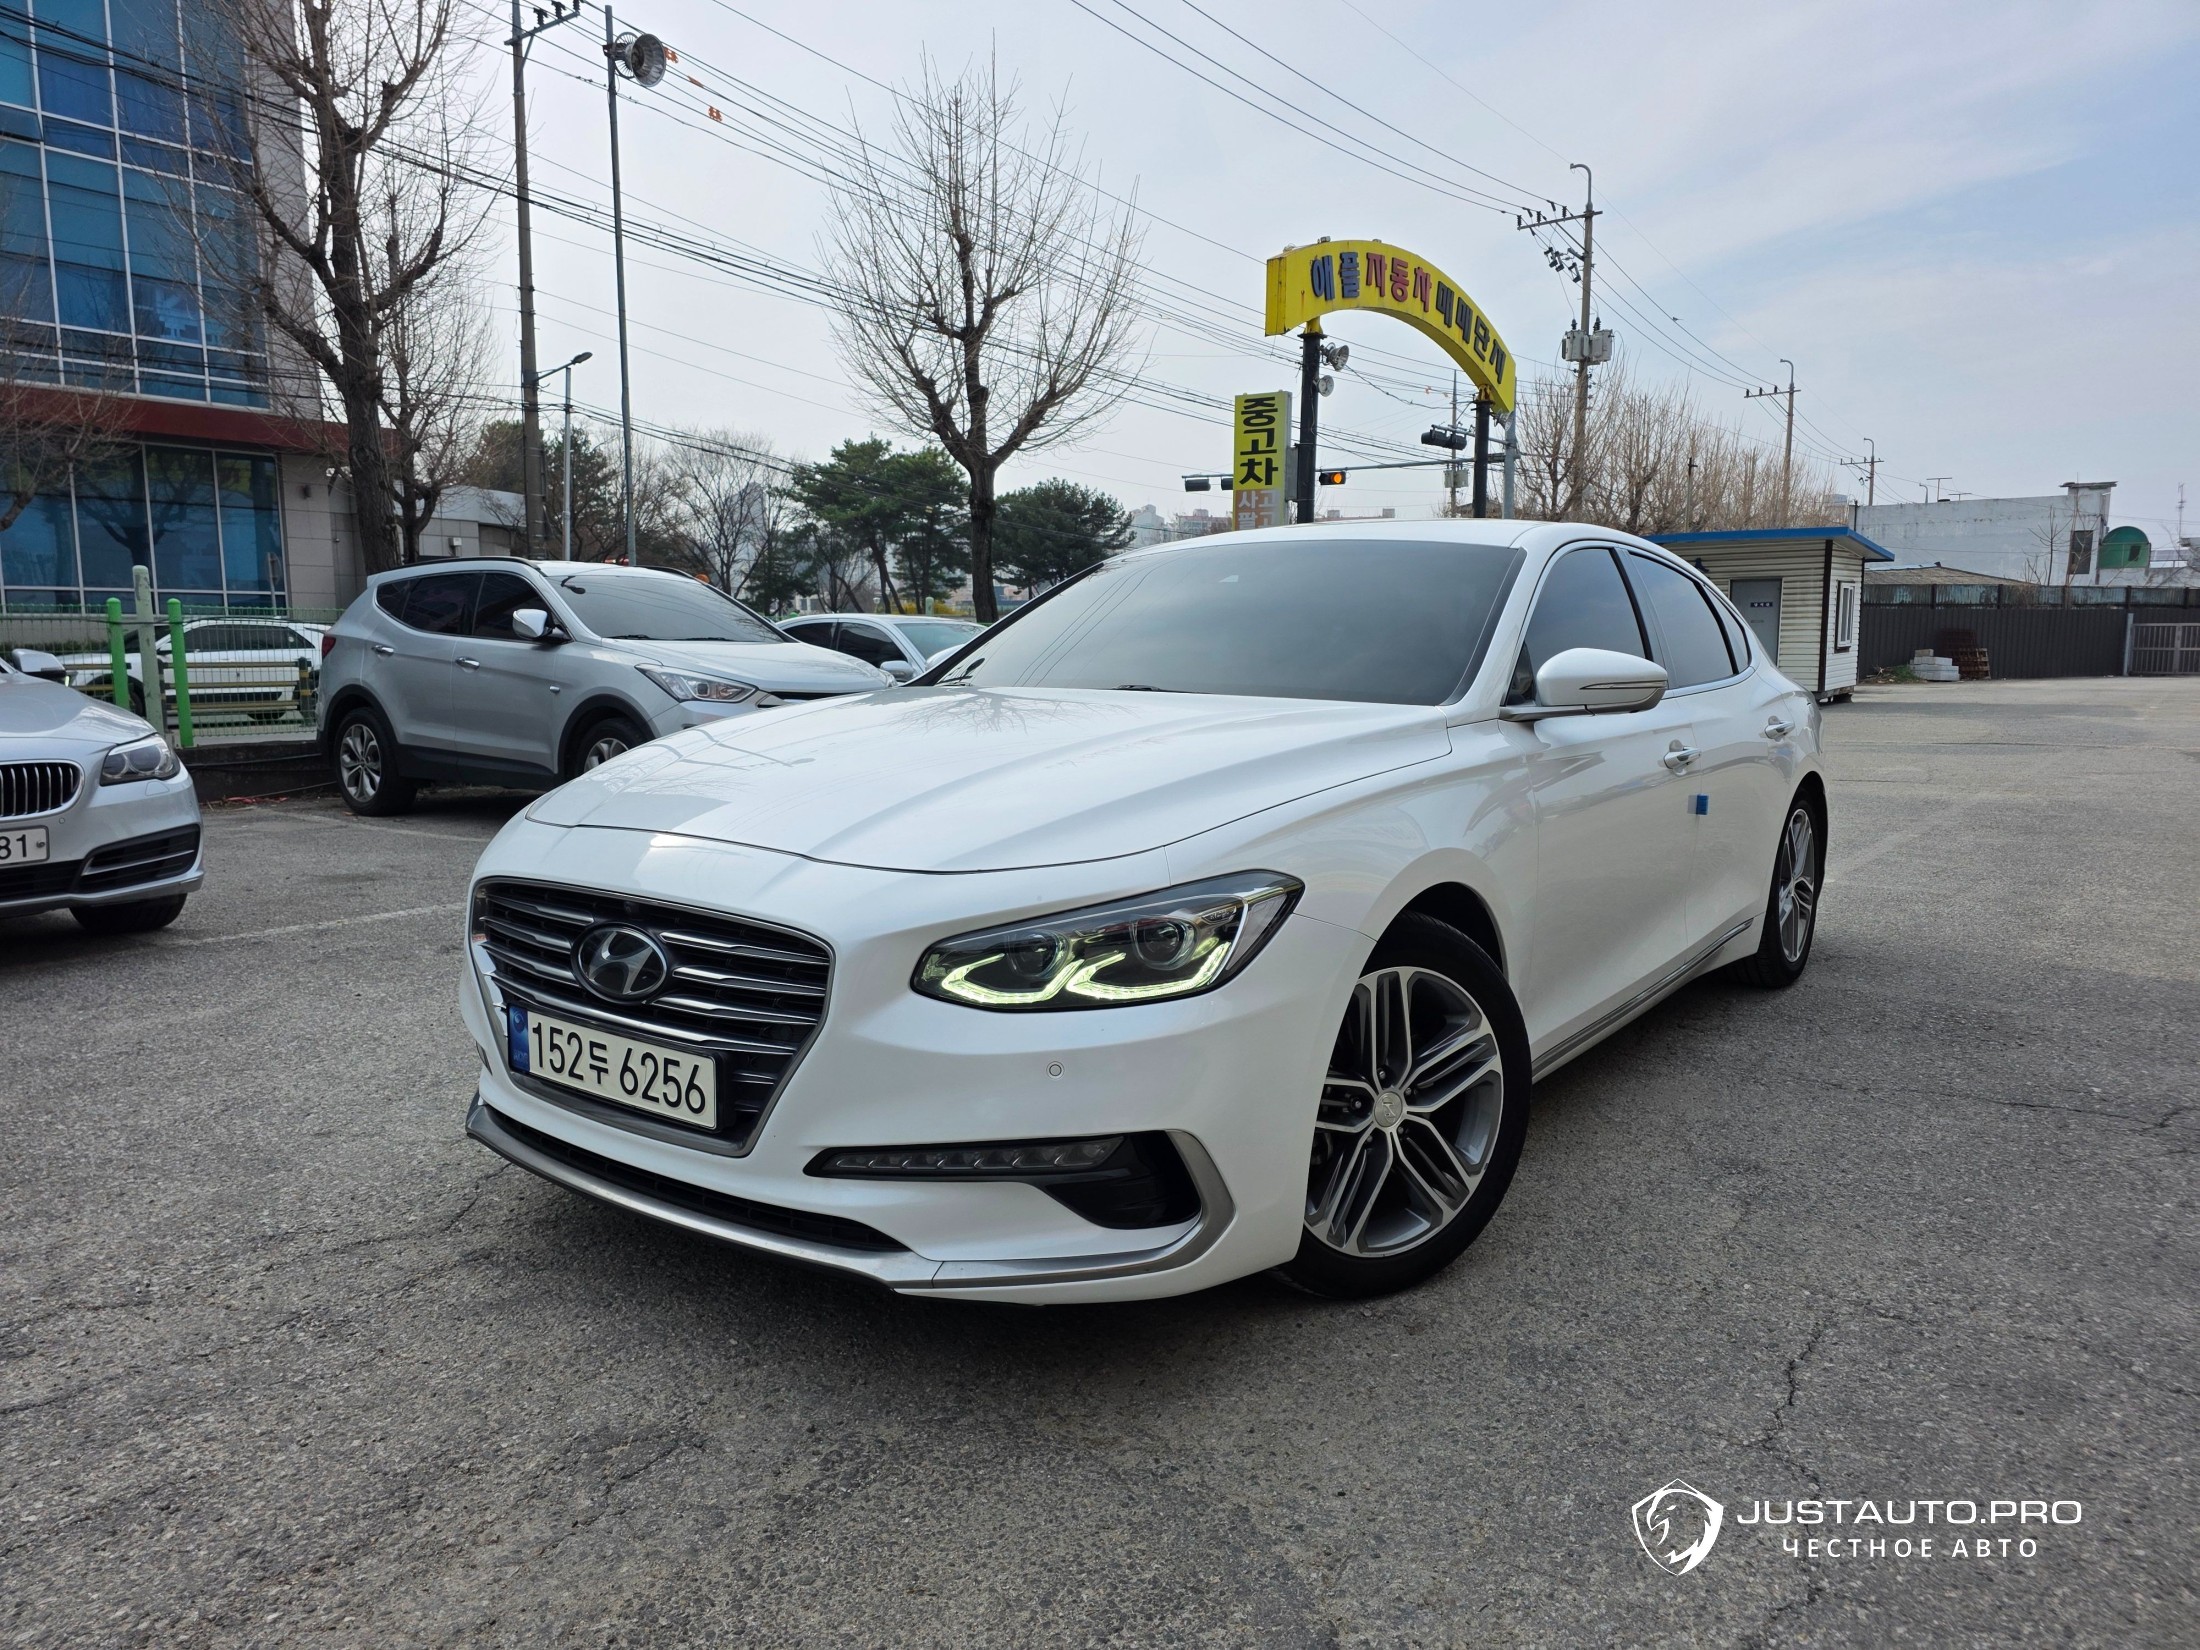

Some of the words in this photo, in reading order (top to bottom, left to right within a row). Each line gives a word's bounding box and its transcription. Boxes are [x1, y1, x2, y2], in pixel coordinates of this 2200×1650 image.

[1239, 396, 1278, 486] 중고차
[532, 1022, 609, 1084] 152두
[619, 1047, 706, 1114] 6256
